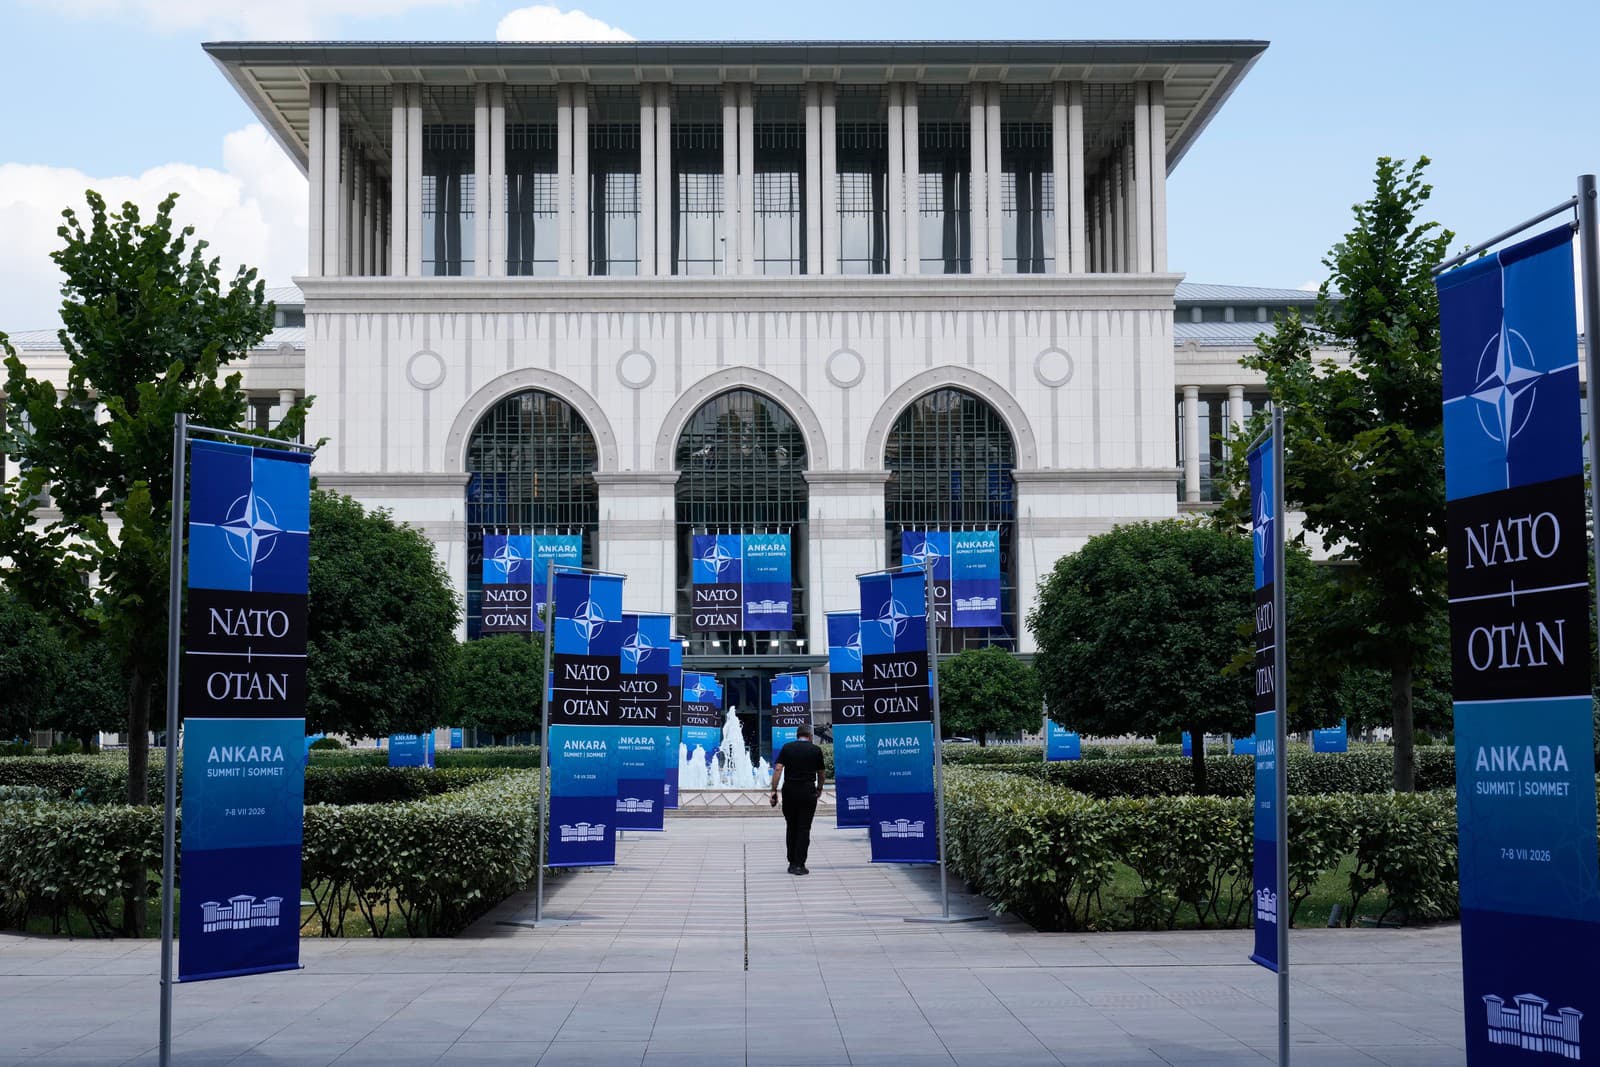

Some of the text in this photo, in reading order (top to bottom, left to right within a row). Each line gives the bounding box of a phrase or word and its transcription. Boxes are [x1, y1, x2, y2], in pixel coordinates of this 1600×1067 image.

[1465, 512, 1560, 569] NATO
[486, 590, 527, 602] NATO
[697, 589, 737, 601] NATO
[209, 608, 289, 637] NATO
[485, 615, 527, 626] OTAN
[696, 614, 737, 625] OTAN
[1256, 601, 1274, 632] NATO
[1468, 620, 1565, 671] OTAN
[565, 664, 609, 681] NATO
[873, 661, 917, 679] NATO
[207, 672, 288, 700] OTAN
[841, 680, 864, 692] NA
[1256, 665, 1274, 696] OTAN
[564, 699, 609, 716] OTAN
[842, 705, 864, 717] OT
[874, 696, 918, 713] OTAN
[564, 740, 606, 750] ANKARA
[618, 737, 655, 745] NKARA
[878, 737, 920, 748] ANKARA
[208, 746, 284, 762] ANKARA
[1475, 745, 1569, 772] ANKARA
[208, 768, 240, 777] SUMMIT
[248, 767, 284, 776] SOMMET
[1476, 781, 1515, 795] SUMMIT
[1525, 782, 1569, 796] SOMMET
[1501, 848, 1550, 861] 7-8 VII 2026
